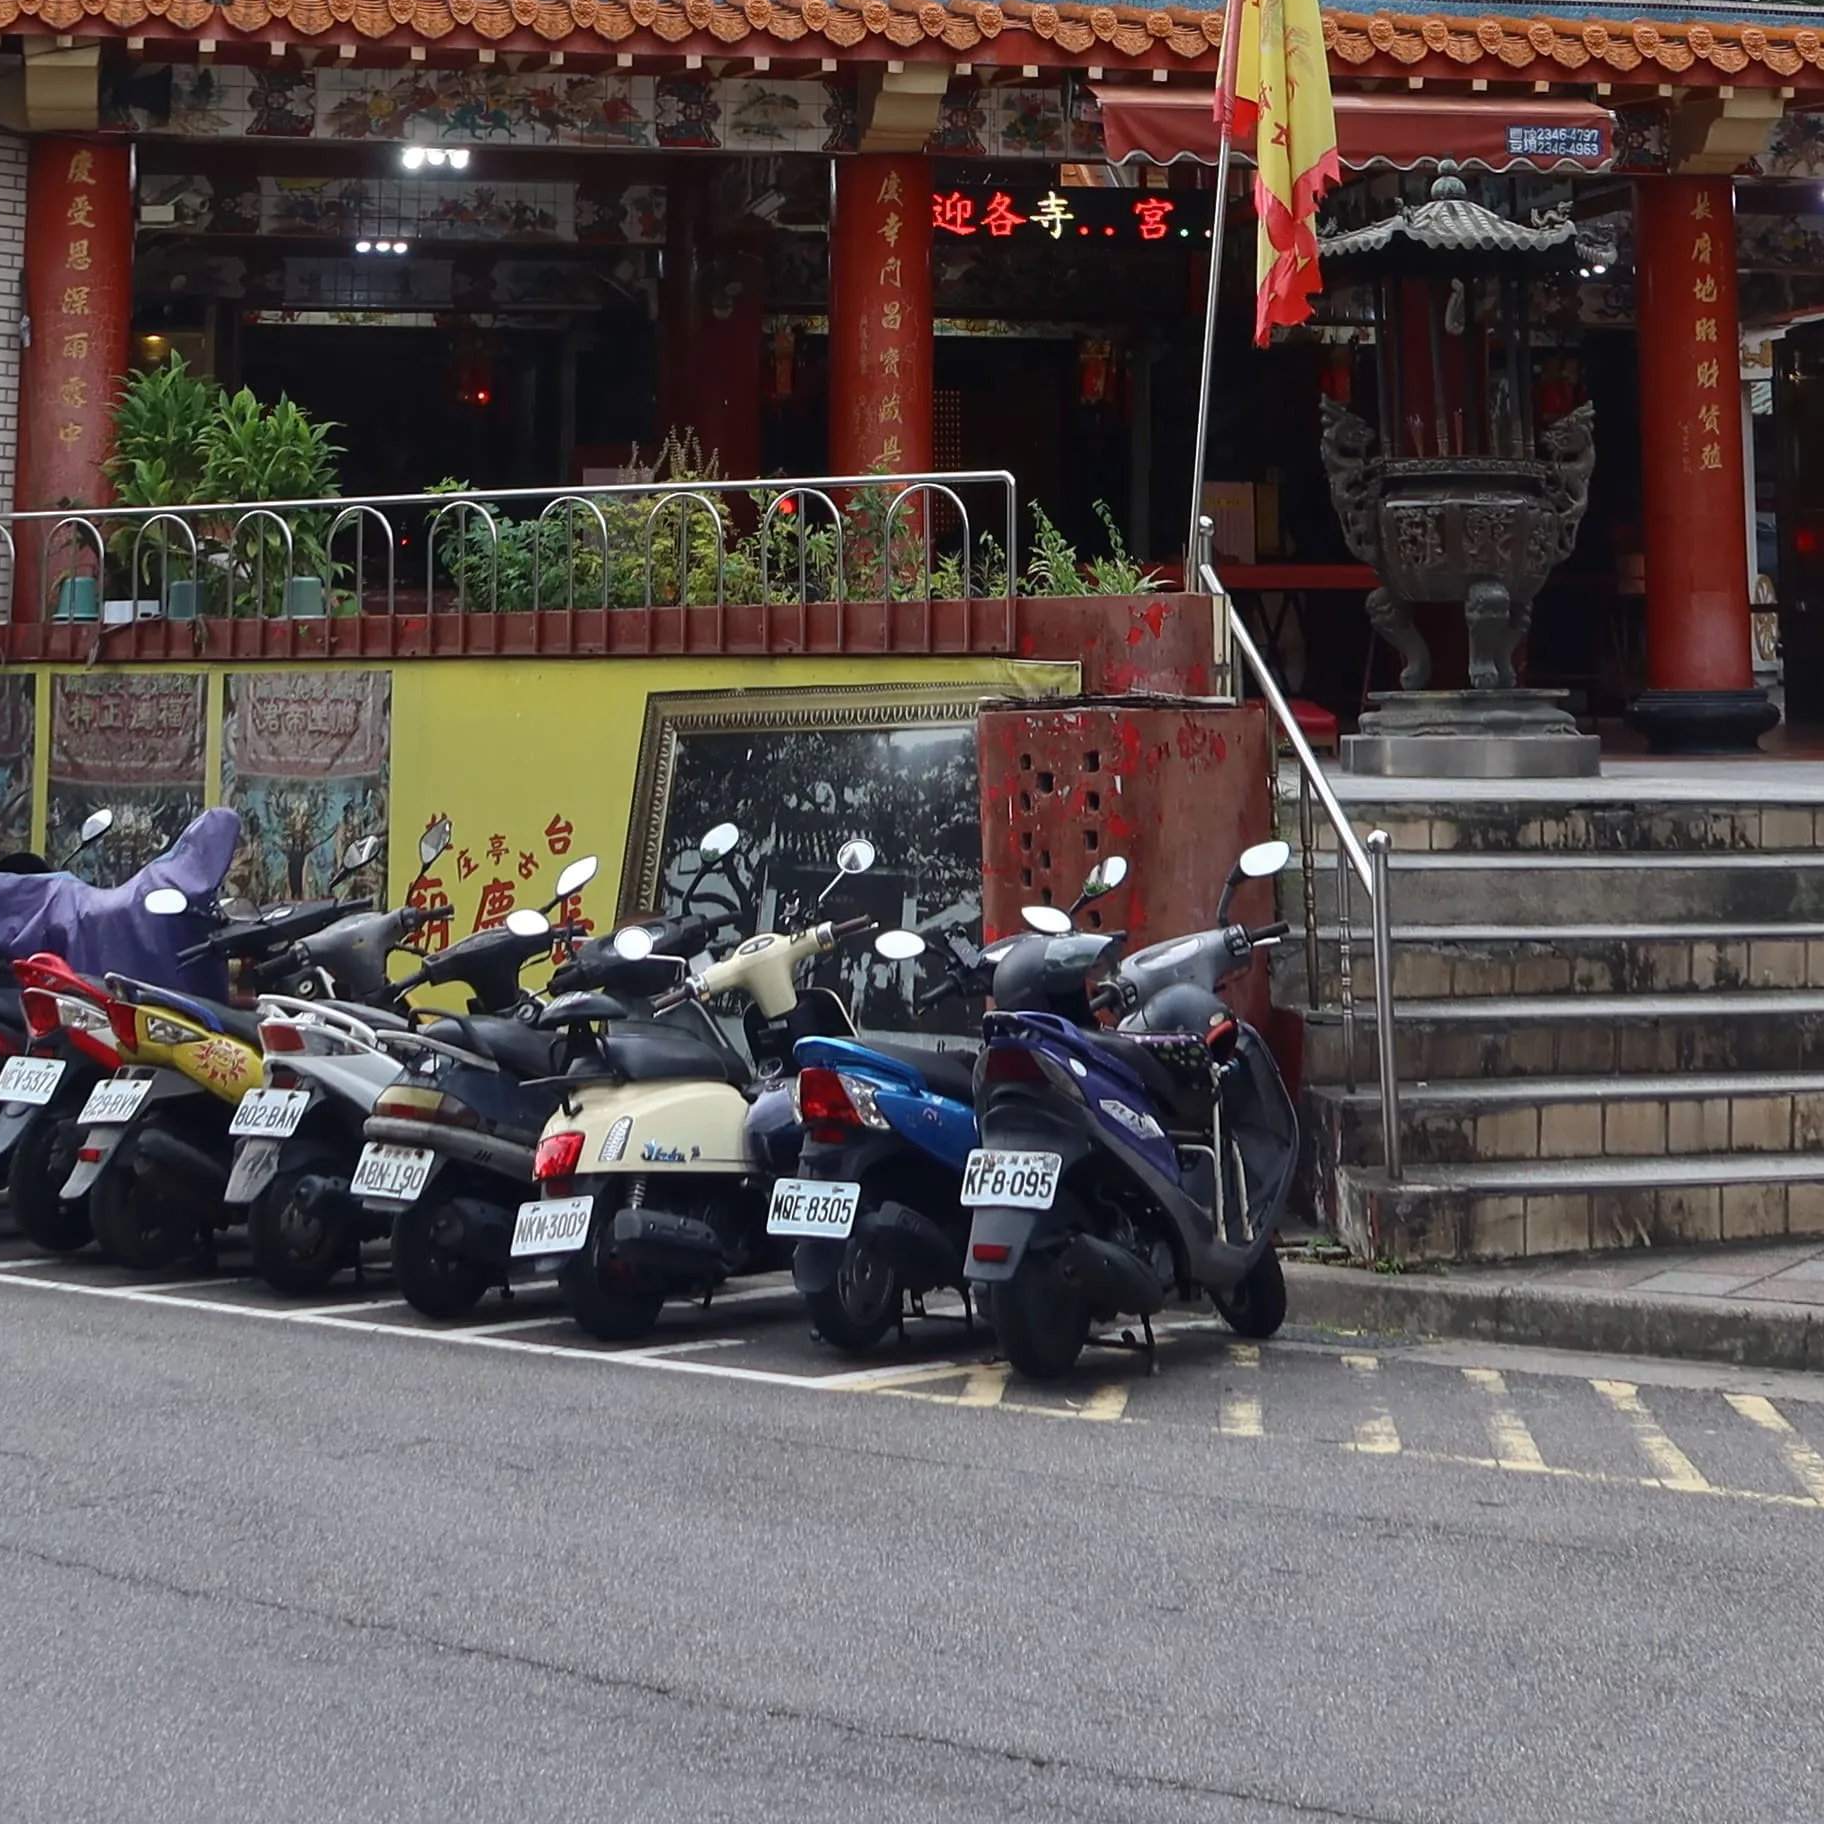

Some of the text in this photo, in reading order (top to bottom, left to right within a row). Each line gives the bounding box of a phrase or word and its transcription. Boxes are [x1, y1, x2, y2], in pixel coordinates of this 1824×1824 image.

[1537, 128, 1599, 143] 2346-4797
[1537, 142, 1599, 156] 2346-4963
[234, 1105, 302, 1127] 802-BAN
[355, 1160, 425, 1190] ABN-190
[964, 1167, 1054, 1198] KF8-095
[771, 1195, 854, 1224] MQE-8305
